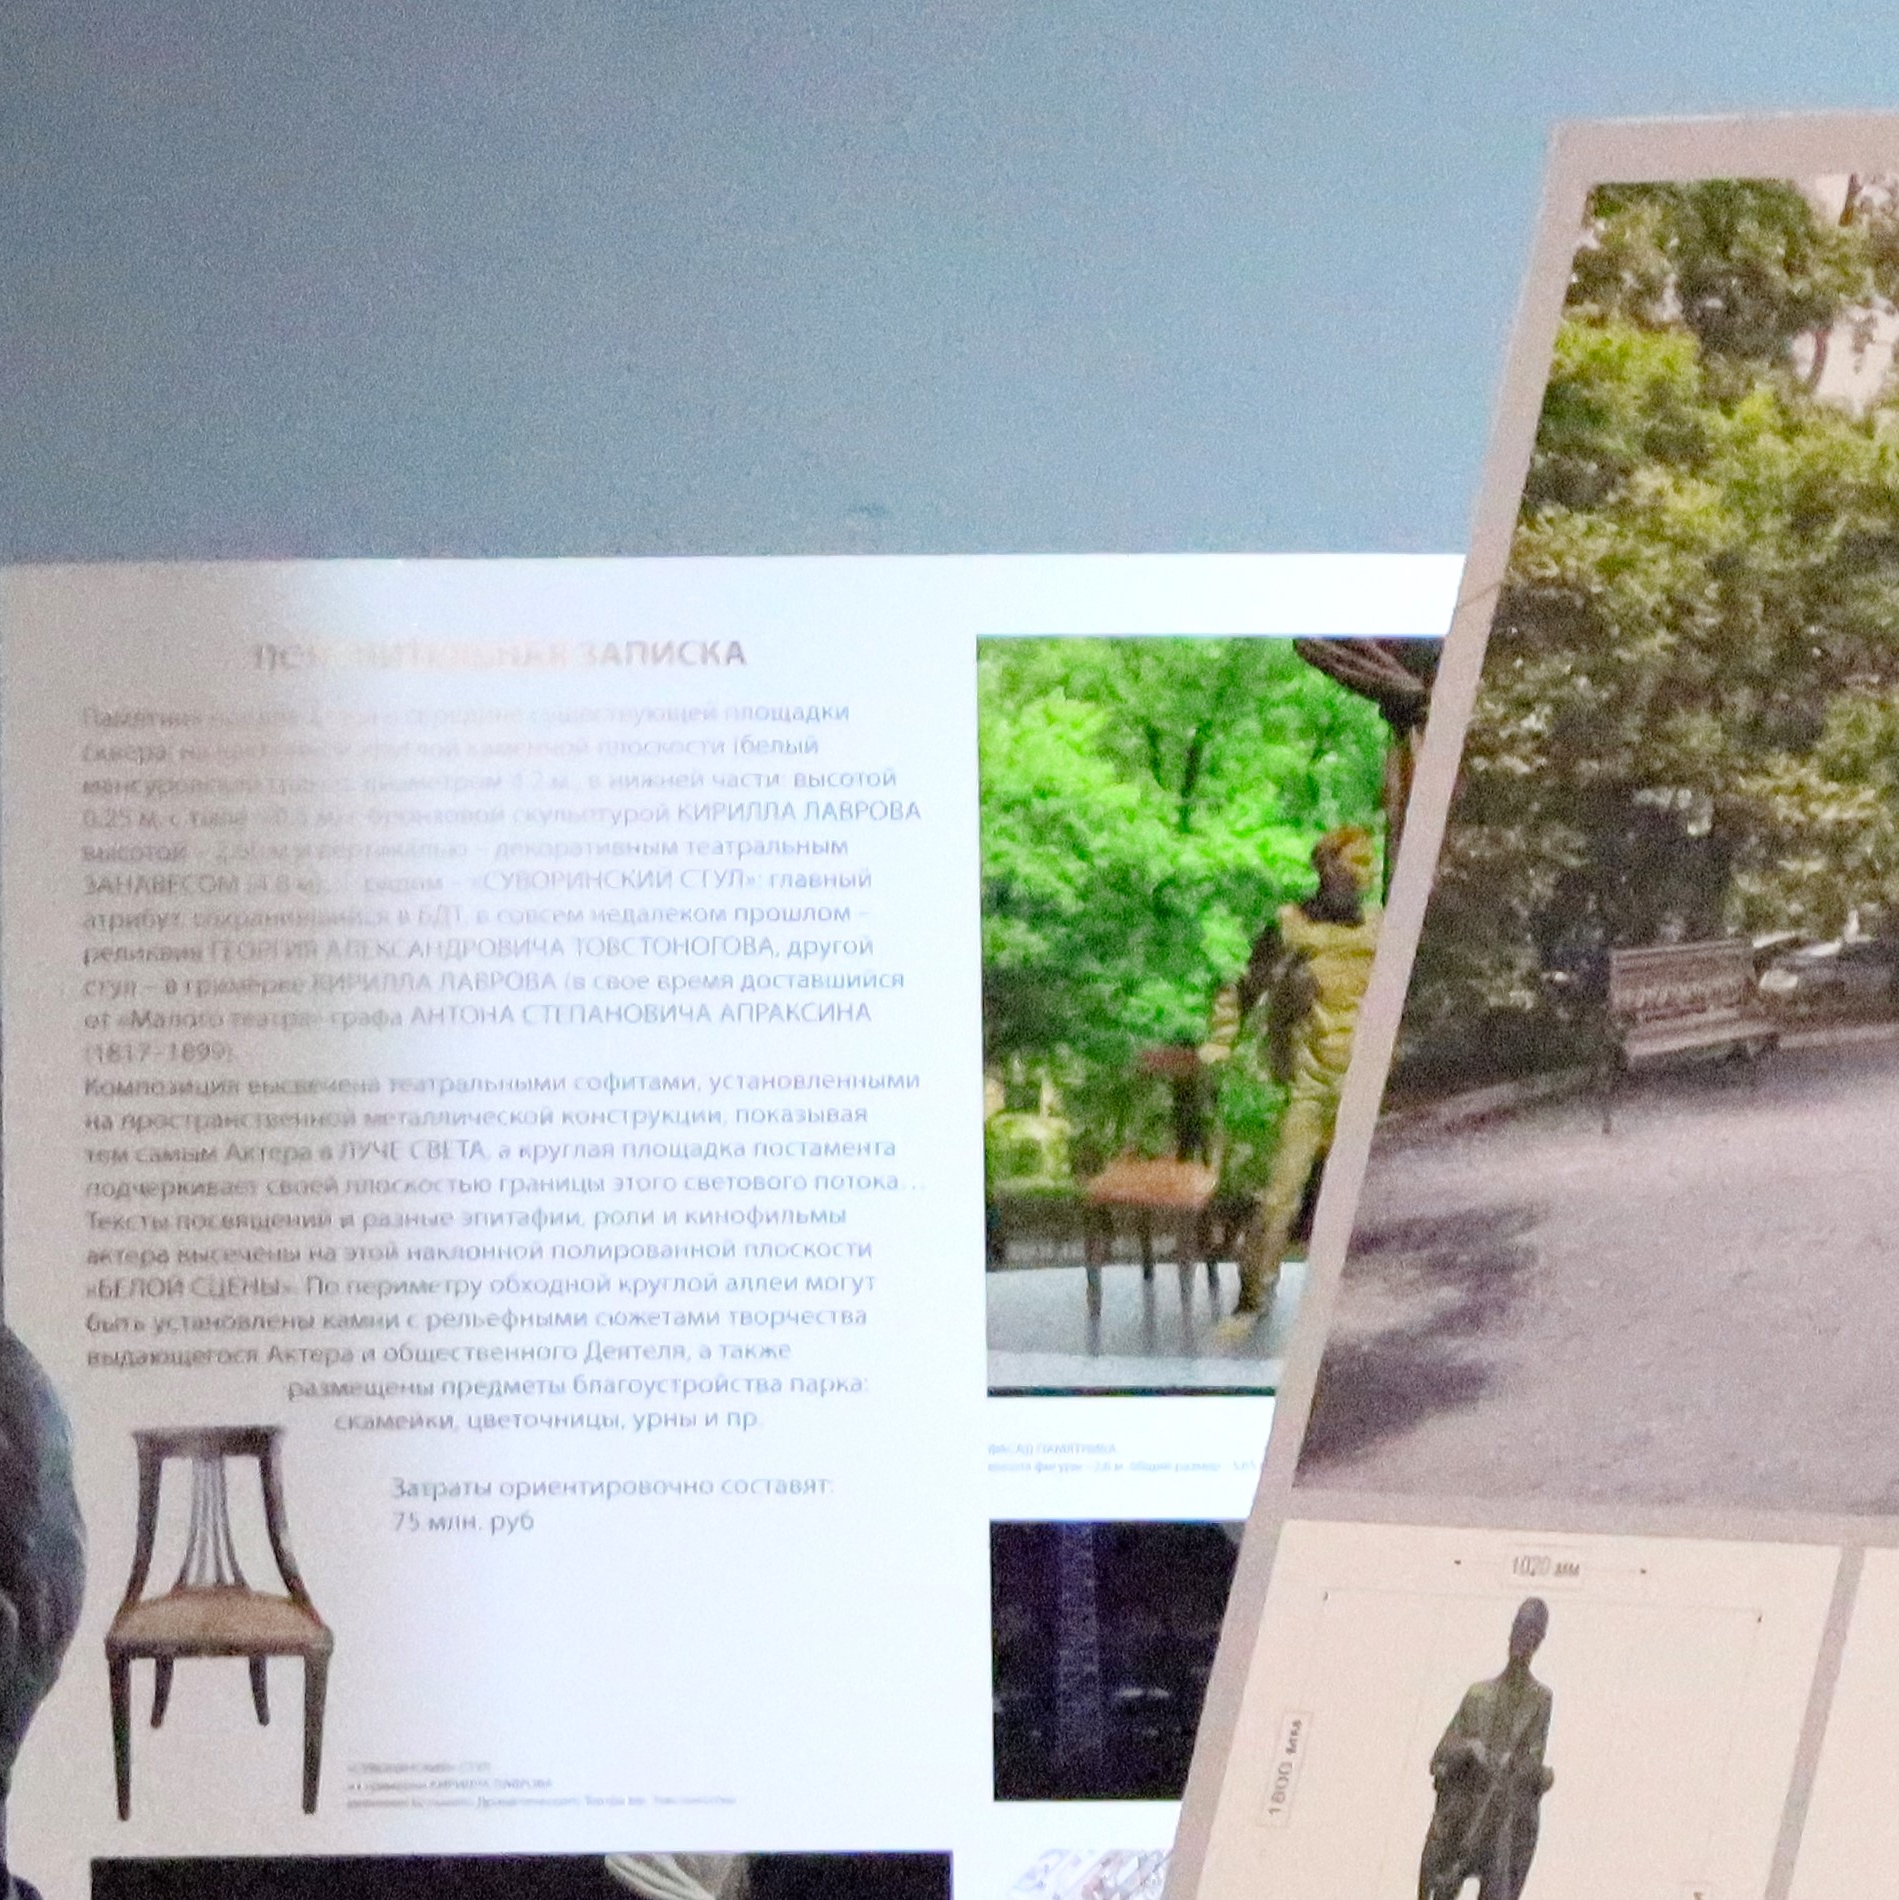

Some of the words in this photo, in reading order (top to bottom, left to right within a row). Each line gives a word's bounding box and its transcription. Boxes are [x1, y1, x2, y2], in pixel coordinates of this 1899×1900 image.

[582, 639, 747, 667] ЗАПИСКА
[725, 705, 850, 725] площадки
[609, 767, 704, 789] нижней
[794, 765, 897, 787] высотой
[513, 801, 670, 828] скульптурой
[678, 800, 795, 822] КИРИЛЛА
[803, 799, 921, 821] ЛАВРОВА
[495, 840, 678, 862] декоративным
[687, 839, 848, 861] театральным
[769, 867, 872, 889] главный
[497, 908, 584, 925] совсем
[591, 907, 726, 927] недалеком
[734, 906, 850, 928] прошлом
[326, 937, 564, 962] АЛЕКСАНДРОВИЧА
[575, 935, 780, 961] ТОВСТОНОГОВА,
[787, 935, 873, 961] другой
[312, 971, 430, 993] КИРИЛЛА
[440, 970, 556, 992] ЛАВРОВА
[593, 974, 650, 991] свое
[657, 973, 734, 995] время
[740, 967, 905, 992] доставшийся
[84, 1013, 111, 1029] от
[330, 1005, 402, 1032] графа
[410, 1004, 514, 1026] АНТОНА
[522, 1003, 711, 1025] СТЕПАНОВИЧА
[720, 1001, 871, 1023] АПРАКСИНА
[84, 1074, 239, 1099] Композиция
[389, 1076, 565, 1098] театральными
[574, 1070, 701, 1097] софитами,
[709, 1073, 920, 1096] установленными
[86, 1114, 113, 1130] на
[363, 1105, 553, 1128] металлической
[562, 1108, 727, 1131] конструкции,
[736, 1107, 868, 1124] показывая
[87, 1147, 129, 1164] тем
[136, 1146, 218, 1163] самым
[225, 1141, 312, 1167] Актера
[320, 1146, 332, 1162] в
[339, 1140, 400, 1161] ЛУЧЕ
[499, 1144, 511, 1160] а
[519, 1143, 614, 1165] круглая
[622, 1142, 746, 1162] площадка
[754, 1141, 895, 1158] постамента
[87, 1179, 257, 1201] подчеркивает
[267, 1173, 339, 1194] своей
[345, 1177, 491, 1194] плоскостью
[500, 1176, 604, 1198] границы
[613, 1175, 676, 1192] этого
[684, 1174, 806, 1191] светового
[87, 1208, 169, 1230] Тексты
[341, 1212, 354, 1228] и
[362, 1211, 453, 1233] разные
[594, 1210, 654, 1231] роли
[664, 1209, 676, 1226] и
[685, 1203, 846, 1230] кинофильмы
[87, 1247, 169, 1269] актера
[178, 1246, 300, 1263] высечены
[310, 1246, 336, 1262] на
[345, 1241, 398, 1262] этой
[407, 1240, 543, 1262] наклонной
[551, 1238, 735, 1266] полированной
[745, 1242, 871, 1259] плоскости
[86, 1273, 184, 1298] «БЕЛОЙ
[306, 1275, 339, 1296] По
[347, 1279, 482, 1301] периметру
[490, 1273, 610, 1298] обходной
[619, 1272, 717, 1299] круглой
[726, 1276, 798, 1293] аллеи
[806, 1276, 877, 1297] могут
[86, 1310, 145, 1332] быть
[153, 1314, 315, 1336] установлены
[322, 1313, 399, 1330] камни
[407, 1313, 417, 1329] с
[427, 1307, 587, 1334] рельефными
[596, 1311, 720, 1328] сюжетами
[730, 1309, 867, 1331] творчества
[87, 1348, 257, 1369] выдающегося
[267, 1342, 354, 1369] Актера
[362, 1347, 375, 1363] и
[384, 1341, 577, 1366] общественного
[584, 1340, 691, 1365] Деятеля,
[699, 1344, 712, 1361] а
[719, 1344, 792, 1360] также
[288, 1380, 434, 1403] размещены
[442, 1379, 565, 1401] предметы
[572, 1373, 783, 1400] благоустройства
[790, 1377, 869, 1399] парка:
[335, 1408, 458, 1433] скамейки,
[468, 1412, 625, 1432] цветочницы,
[633, 1411, 696, 1433] урны
[705, 1411, 718, 1427] и
[392, 1476, 492, 1503] Затраты
[500, 1479, 714, 1502] ориентировочно
[721, 1478, 833, 1495] составят:
[393, 1510, 421, 1532] 75
[429, 1514, 483, 1531] млн.
